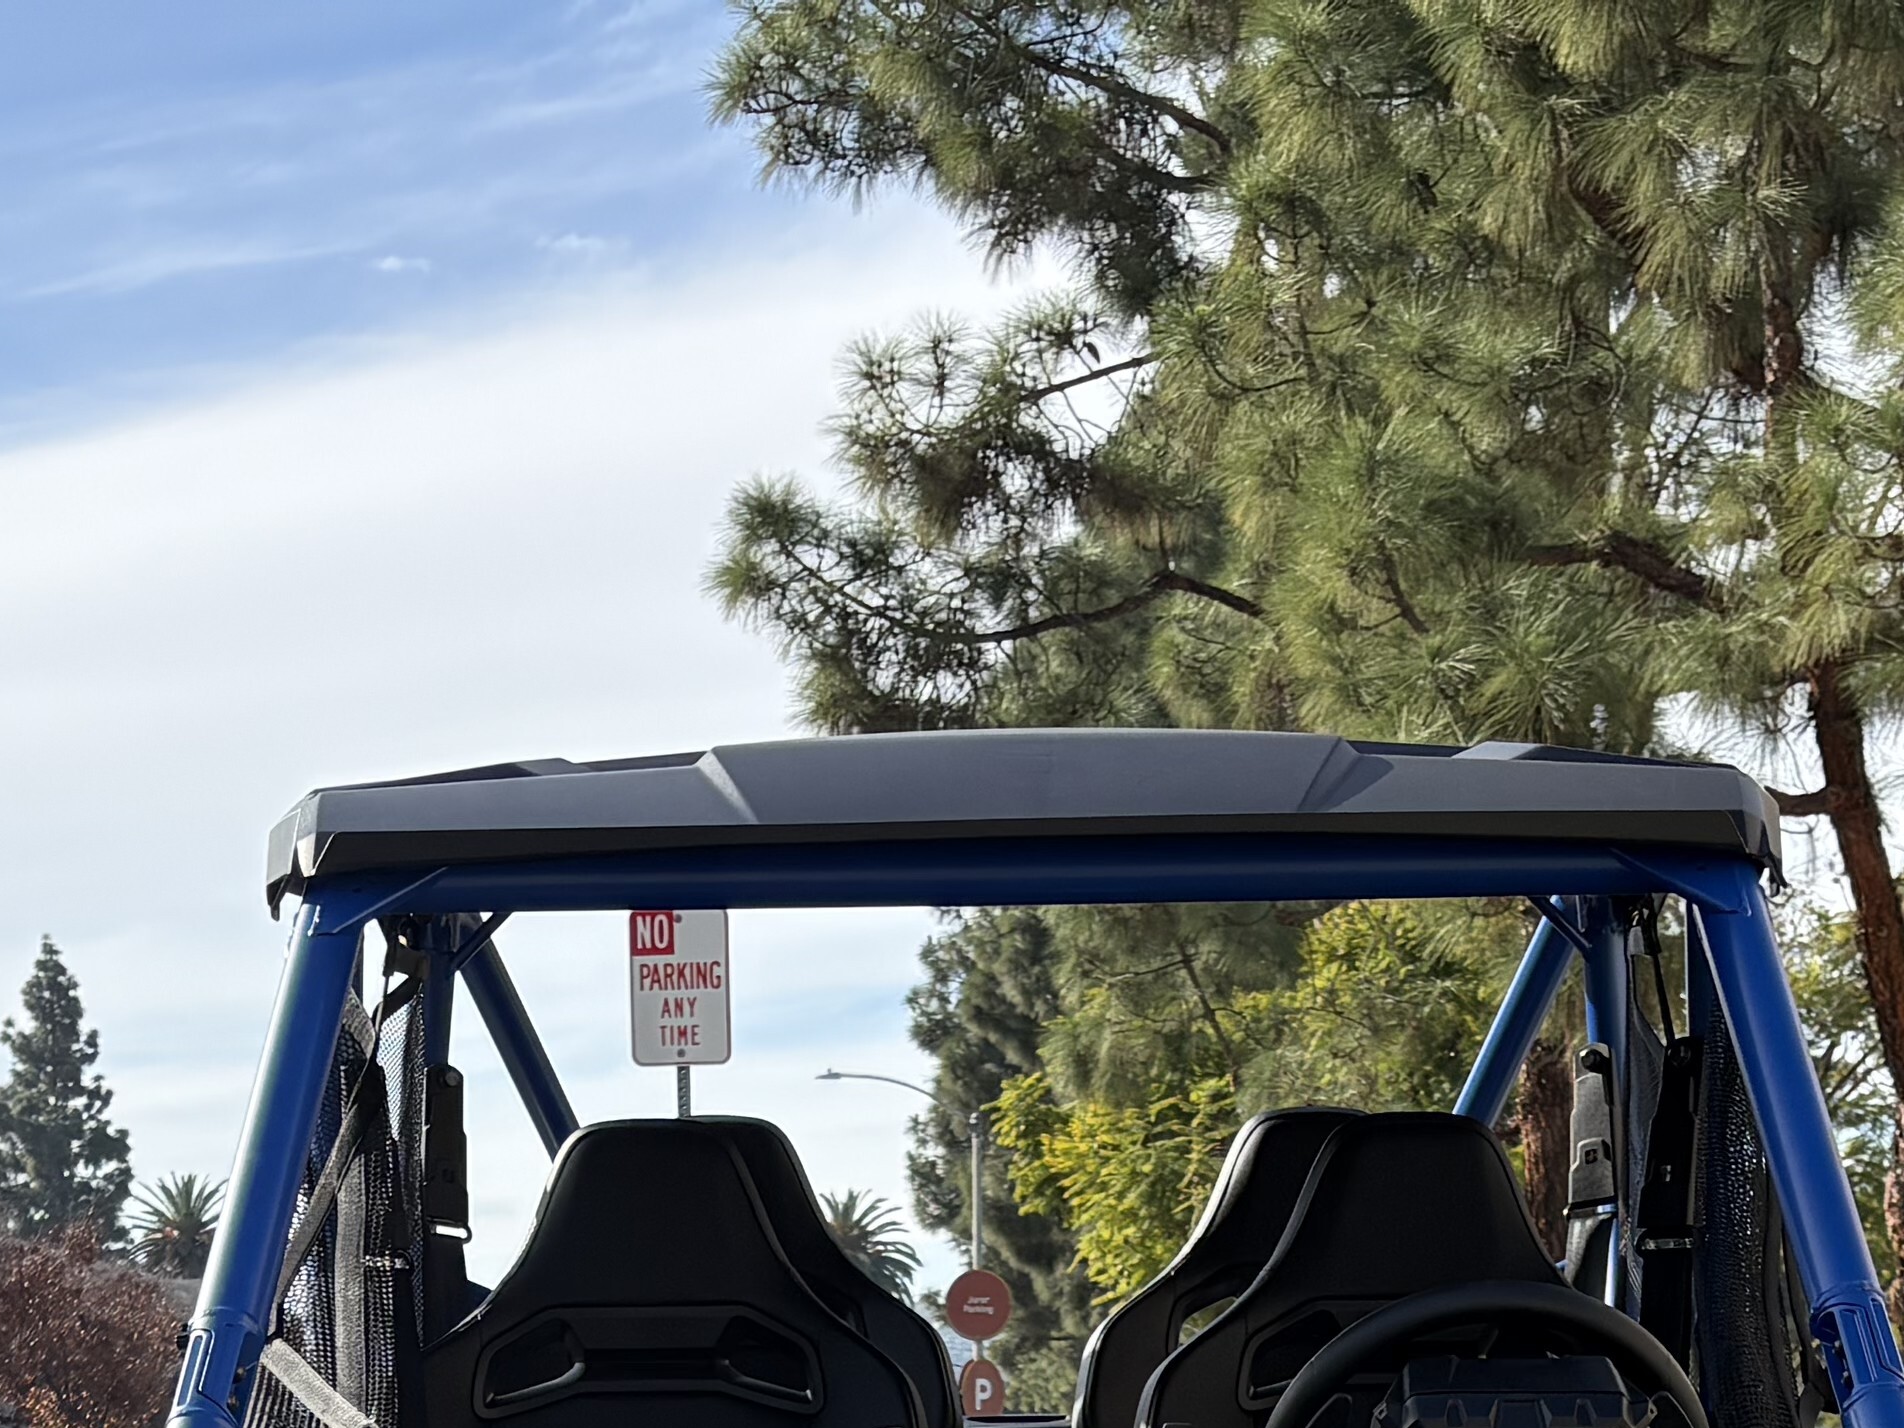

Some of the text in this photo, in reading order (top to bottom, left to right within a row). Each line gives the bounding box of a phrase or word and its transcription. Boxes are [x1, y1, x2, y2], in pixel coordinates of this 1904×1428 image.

[636, 914, 669, 949] NO
[639, 961, 722, 992] PARKING
[661, 997, 697, 1019] ANY
[659, 1025, 701, 1047] TIME
[975, 1378, 992, 1411] P
